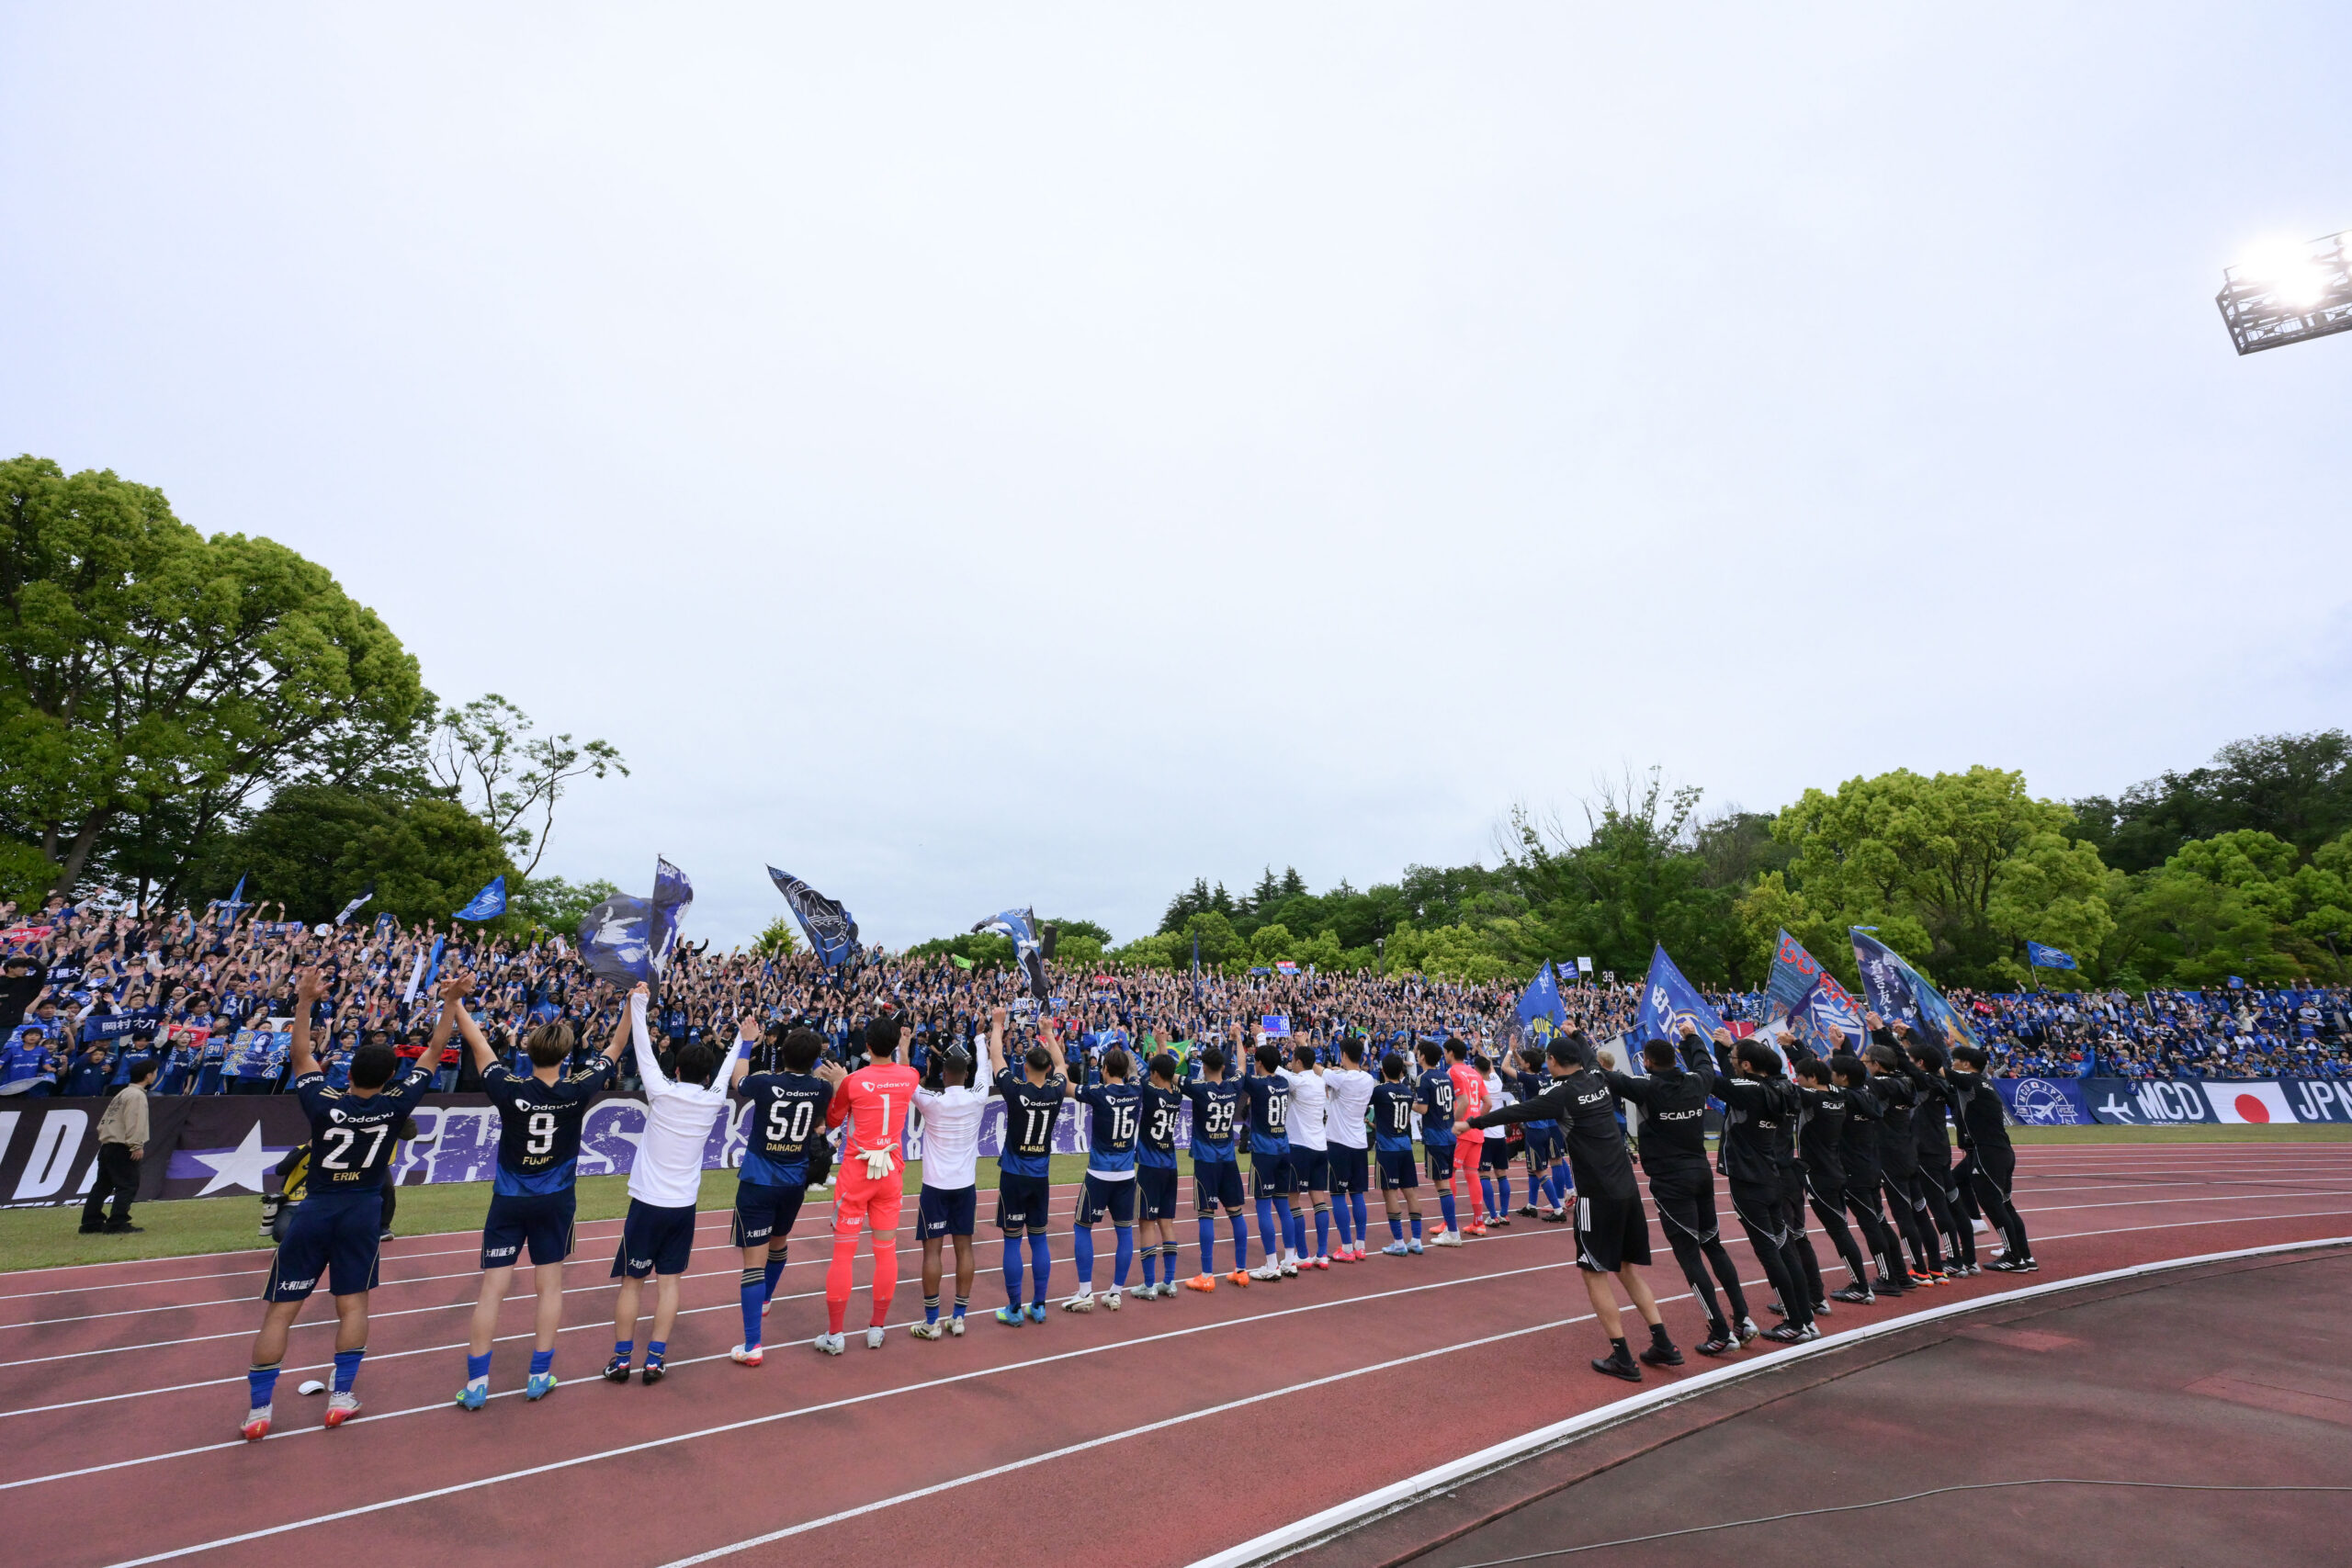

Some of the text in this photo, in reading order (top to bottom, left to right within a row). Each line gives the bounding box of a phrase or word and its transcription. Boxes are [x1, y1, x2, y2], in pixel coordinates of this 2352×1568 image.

[1602, 971, 1614, 983] 39
[1436, 1085, 1453, 1113] 49
[2137, 1081, 2204, 1120] MCD
[346, 1111, 394, 1123] odakyu
[765, 1100, 814, 1142] 50
[879, 1093, 890, 1136] 1
[1023, 1110, 1050, 1145] 11
[1112, 1105, 1136, 1140] 16
[1205, 1101, 1236, 1133] 39
[1393, 1101, 1408, 1130] 10
[322, 1123, 389, 1169] 27
[526, 1112, 560, 1155] 9
[765, 1142, 803, 1153] DAIHACHI
[333, 1171, 361, 1181] ERIK
[746, 1225, 774, 1238] 大和証券
[484, 1246, 516, 1258] 大和証券
